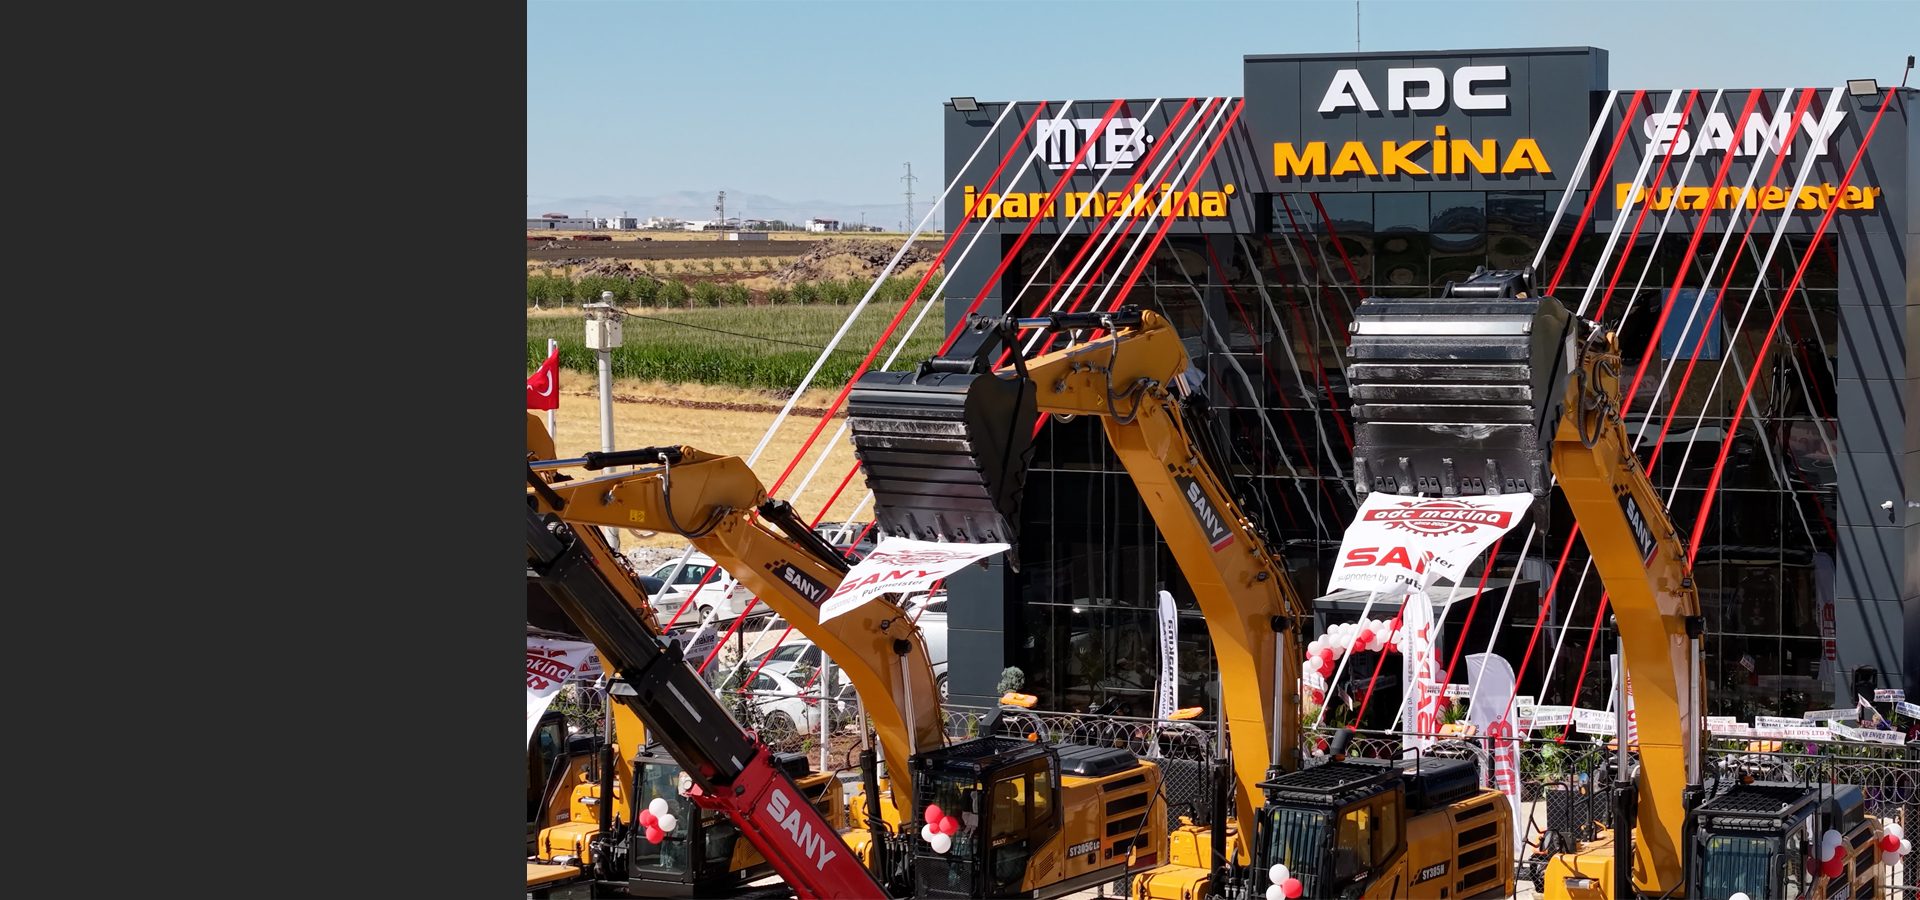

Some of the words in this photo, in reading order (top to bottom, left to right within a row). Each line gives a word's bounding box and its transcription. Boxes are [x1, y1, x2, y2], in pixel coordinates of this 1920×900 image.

[1317, 65, 1506, 112] ADC
[1037, 118, 1146, 168] MTB
[1273, 125, 1553, 176] MAKİNA
[1643, 111, 1847, 156] SANY
[964, 185, 1055, 218] inan
[1065, 183, 1228, 218] makina
[1616, 182, 1881, 211] Putzmeister
[1187, 481, 1223, 538] SANY
[1374, 510, 1415, 519] adc
[1419, 510, 1501, 522] makina
[1626, 497, 1652, 553] SANY
[784, 566, 820, 600] SANY
[832, 570, 945, 598] SANY
[766, 788, 836, 871] SANY
